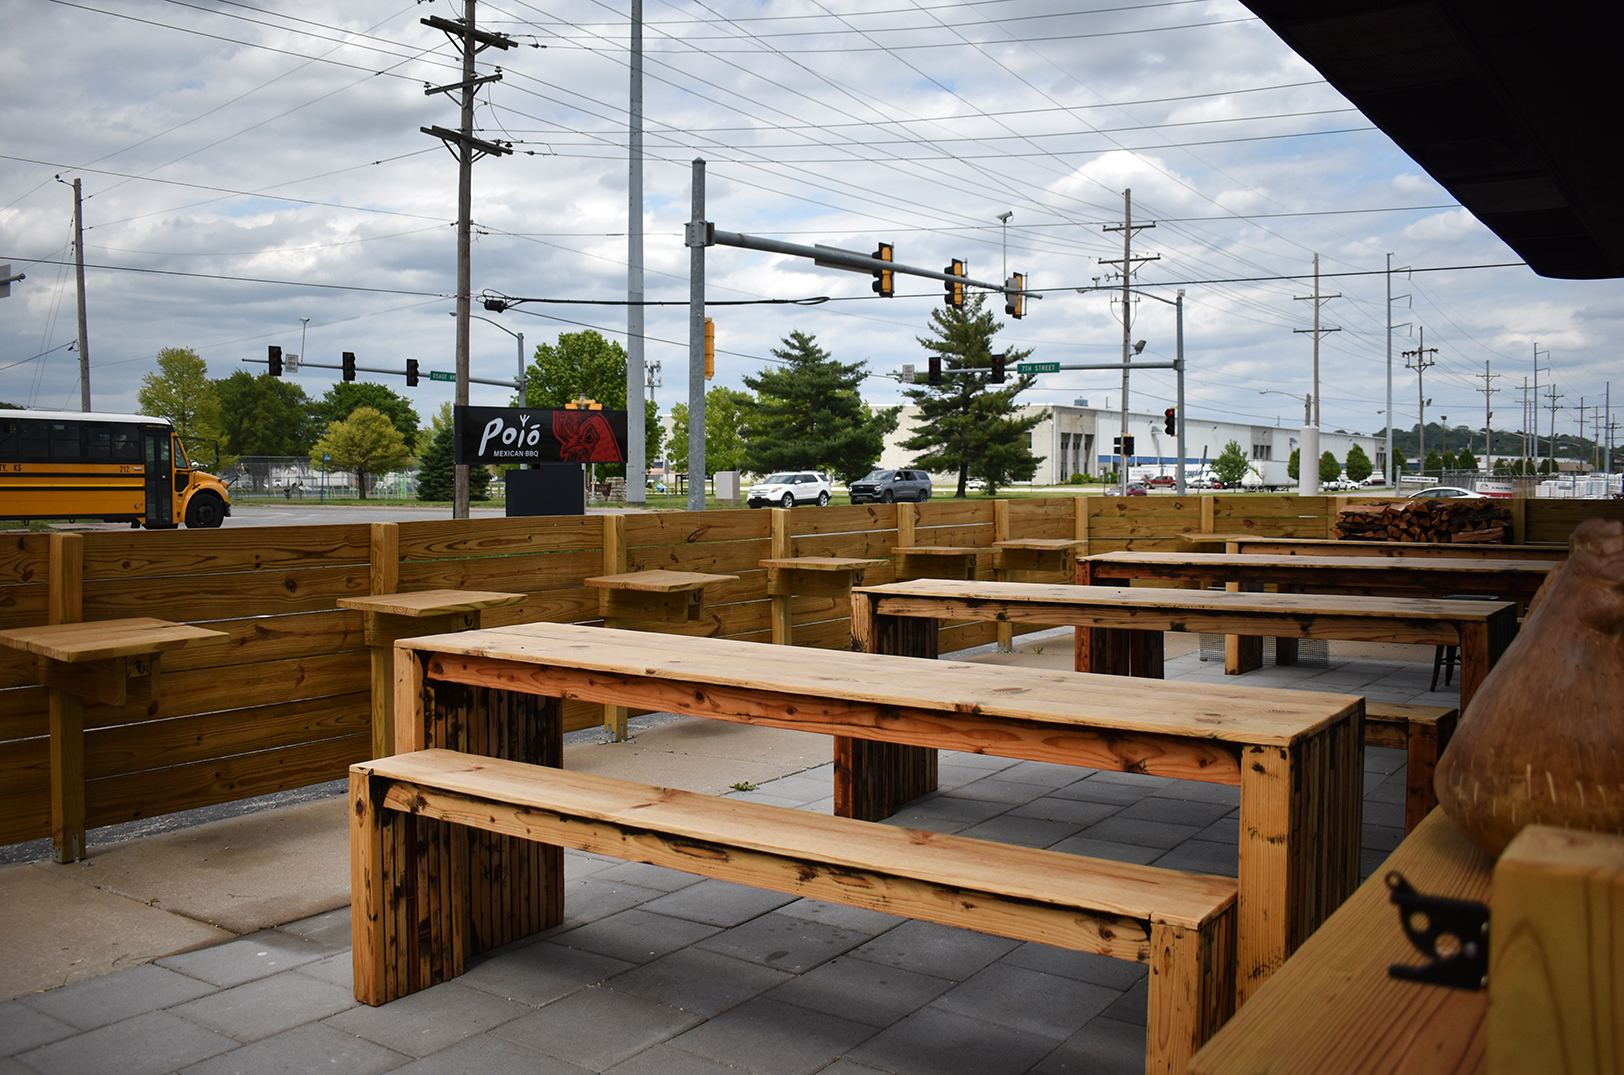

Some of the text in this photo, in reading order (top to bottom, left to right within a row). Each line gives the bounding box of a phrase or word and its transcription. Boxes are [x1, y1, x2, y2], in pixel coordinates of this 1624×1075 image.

[493, 450, 539, 458] MEXICAN BBQ
[13, 463, 22, 472] KS
[119, 465, 130, 473] 212
